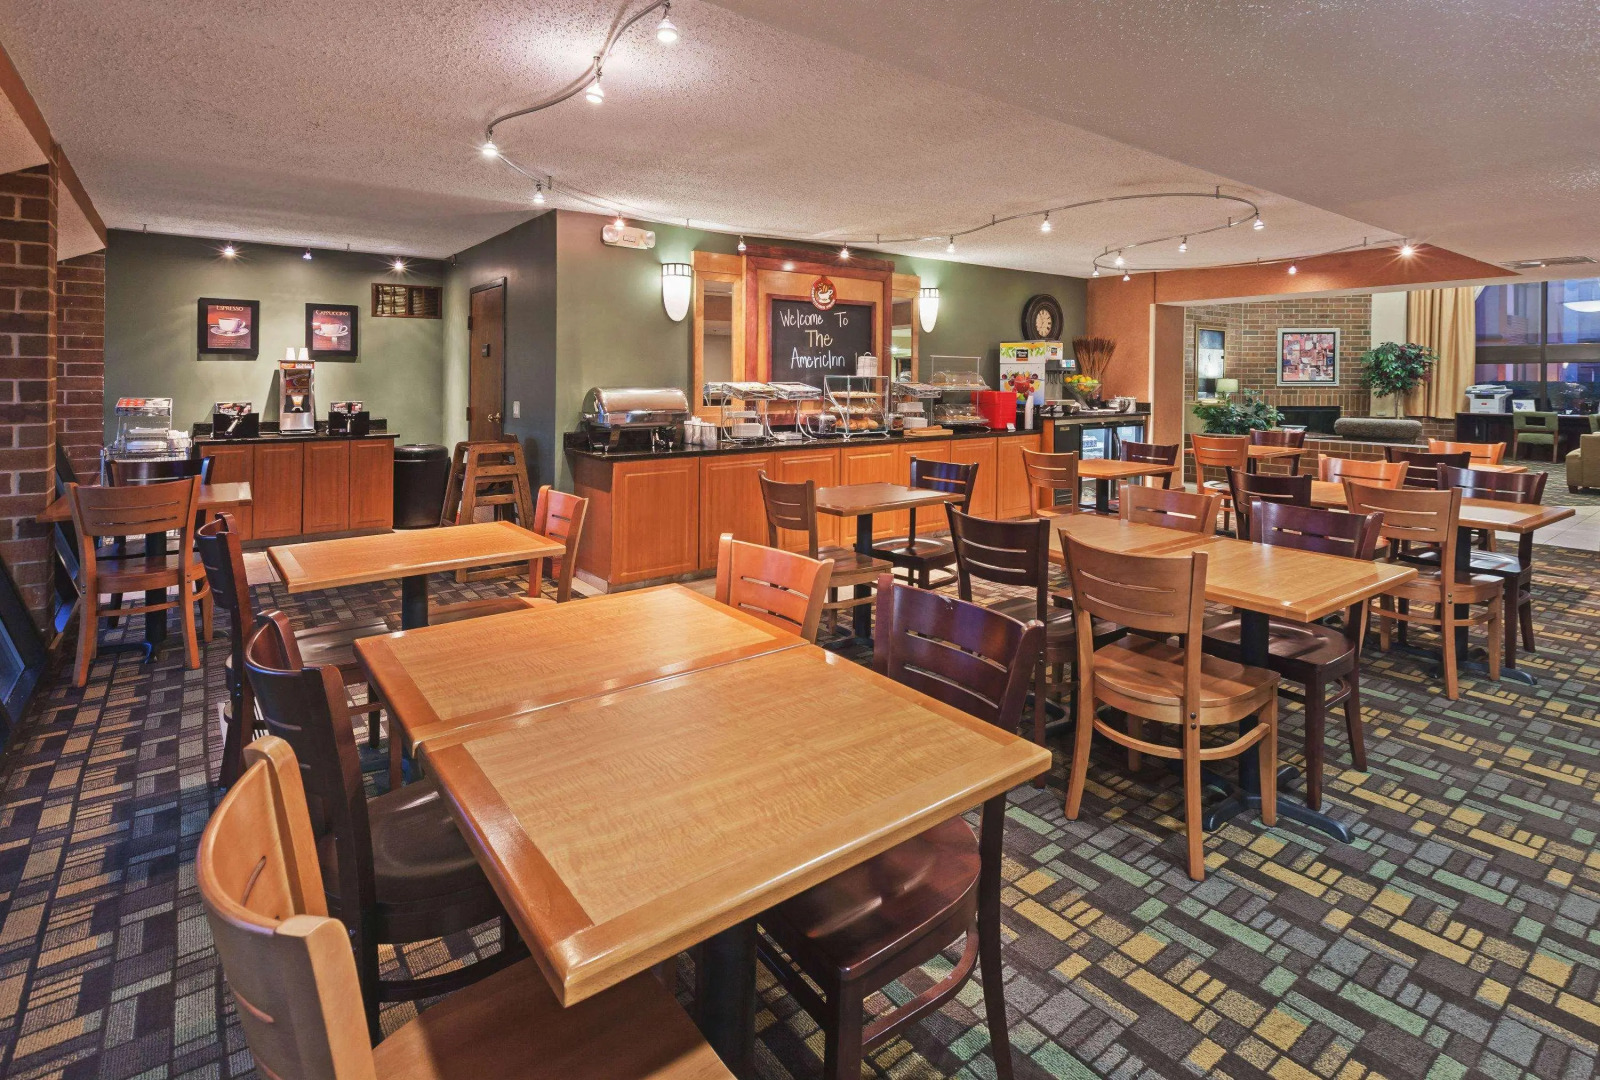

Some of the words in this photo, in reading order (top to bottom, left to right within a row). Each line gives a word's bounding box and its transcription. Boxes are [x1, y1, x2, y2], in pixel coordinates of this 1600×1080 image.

[315, 309, 349, 317] CAPPUCCINO
[779, 308, 824, 329] Welcome
[834, 311, 849, 328] To
[805, 329, 833, 348] The
[790, 347, 846, 370] AmericInn
